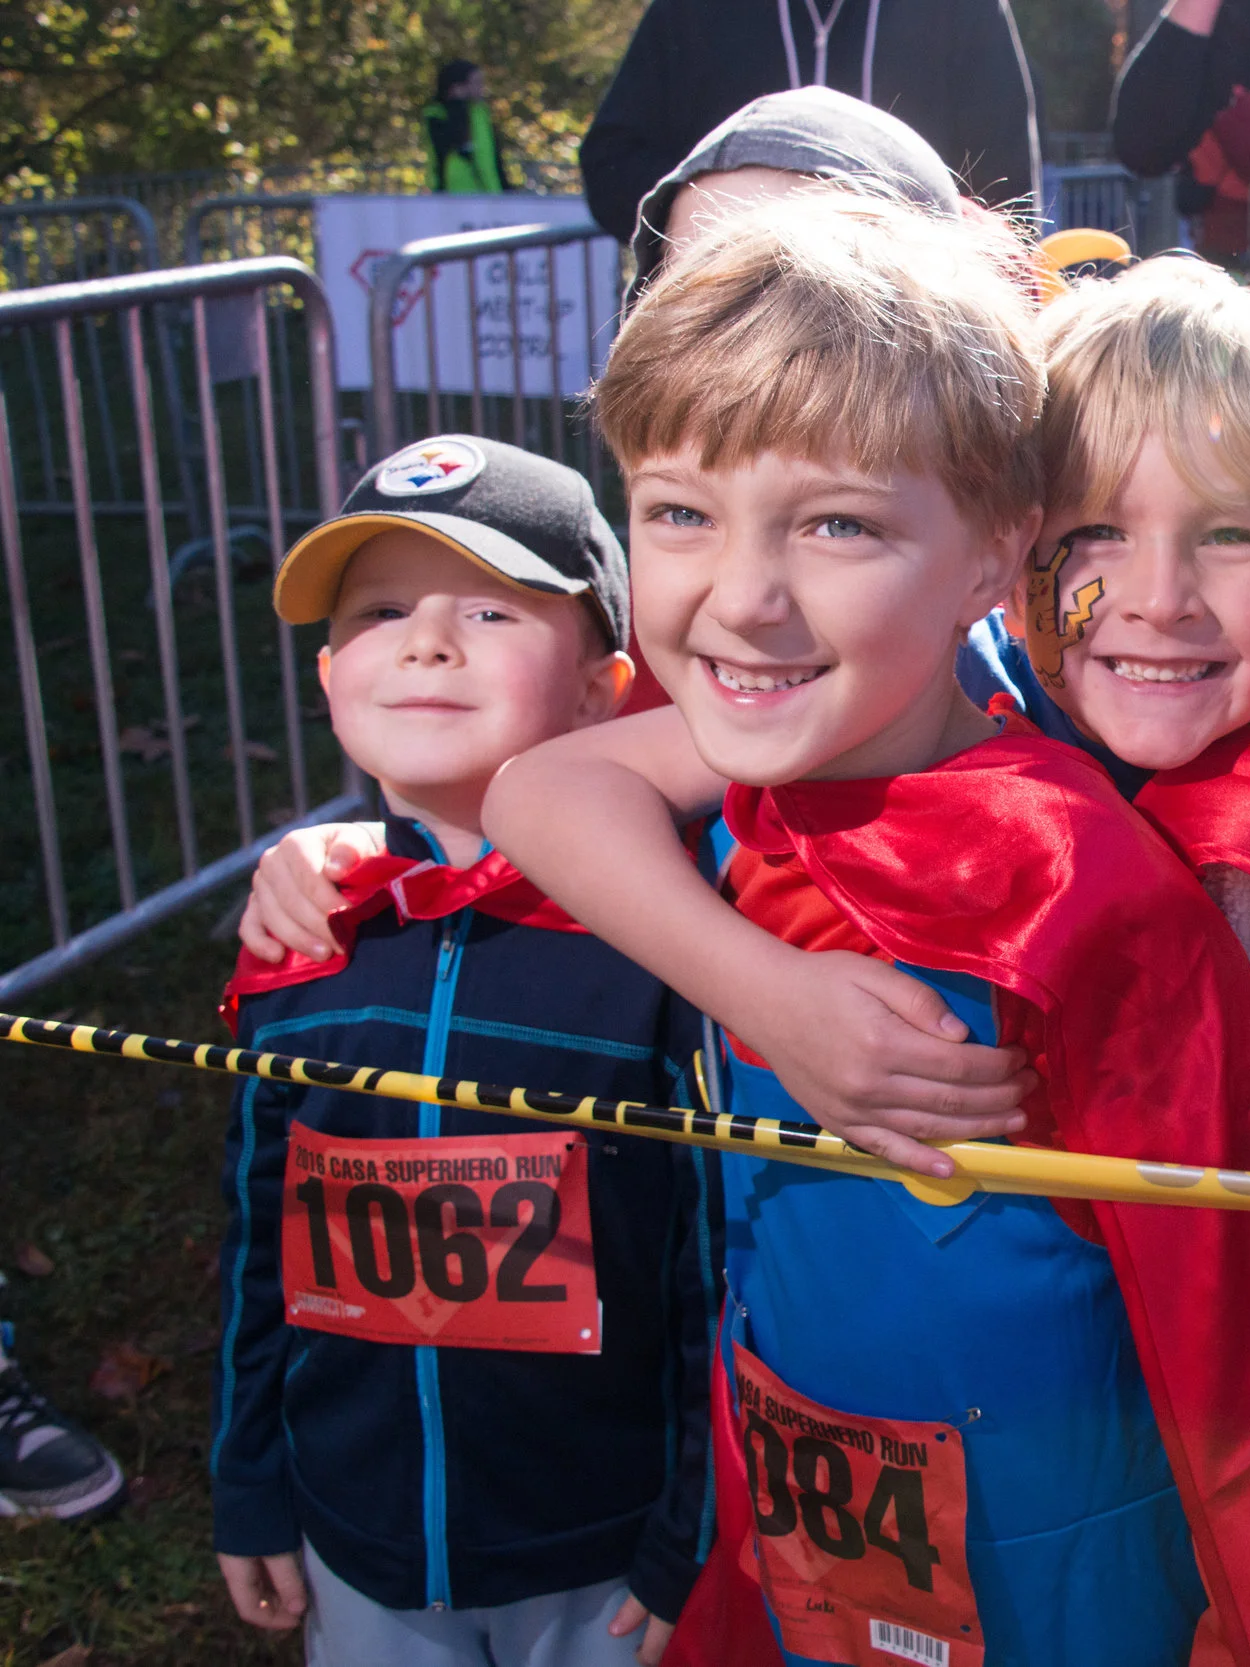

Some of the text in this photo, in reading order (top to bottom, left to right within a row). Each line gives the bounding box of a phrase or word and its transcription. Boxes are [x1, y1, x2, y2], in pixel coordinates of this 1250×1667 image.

[295, 1144, 562, 1183] 2016 CASA SUPERHERO RUN
[296, 1175, 568, 1304] 1062
[765, 1395, 875, 1455] SUPERHERO
[880, 1434, 928, 1468] RUN
